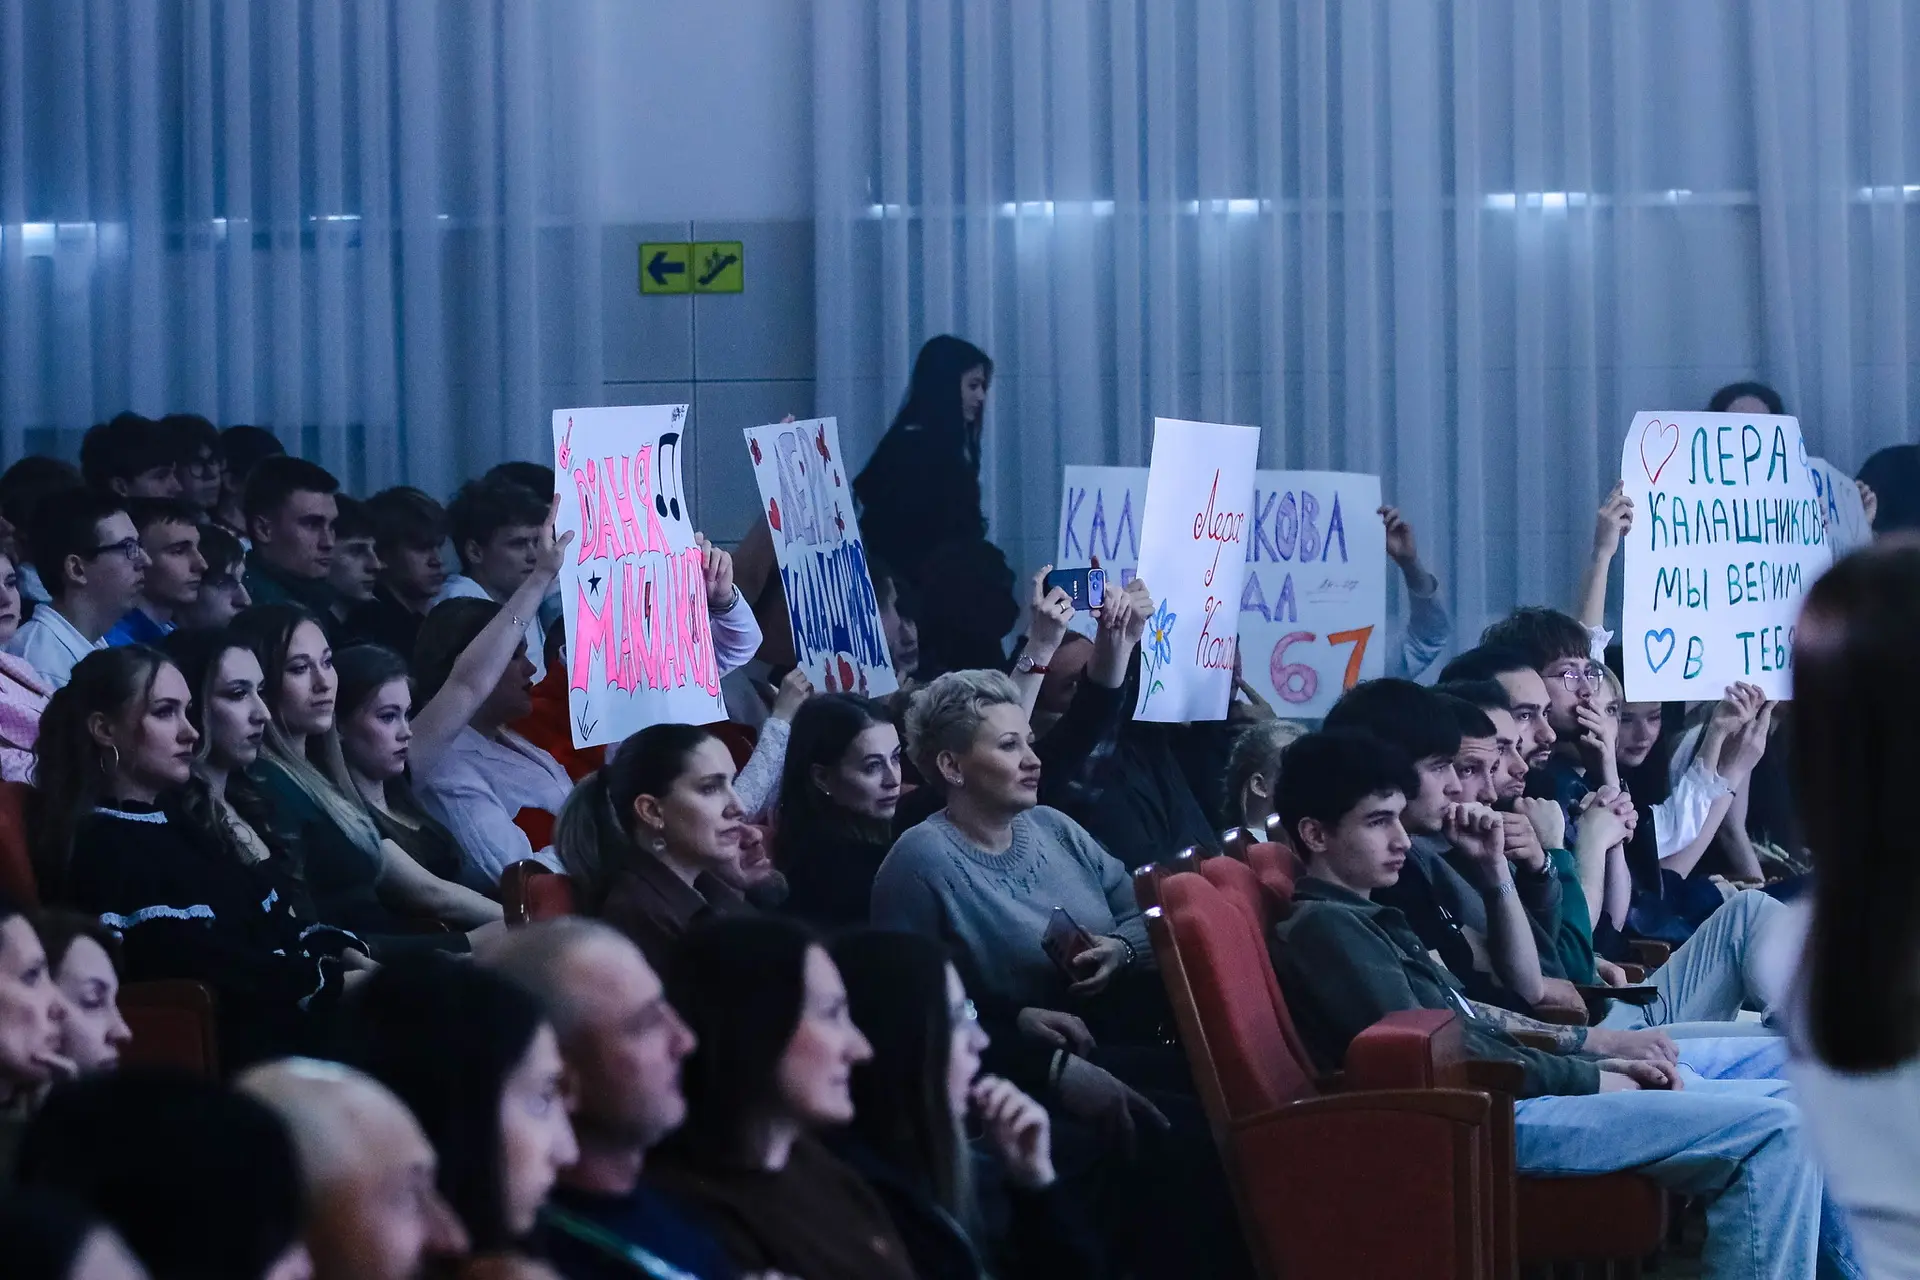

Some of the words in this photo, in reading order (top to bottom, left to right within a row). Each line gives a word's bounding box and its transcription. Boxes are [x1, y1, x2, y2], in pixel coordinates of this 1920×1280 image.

[1688, 424, 1788, 486] ЛЕРА
[1653, 566, 1708, 611] МЫ
[1727, 561, 1802, 606] ВЕРИМ
[1270, 624, 1375, 704] 67
[1683, 635, 1704, 679] В
